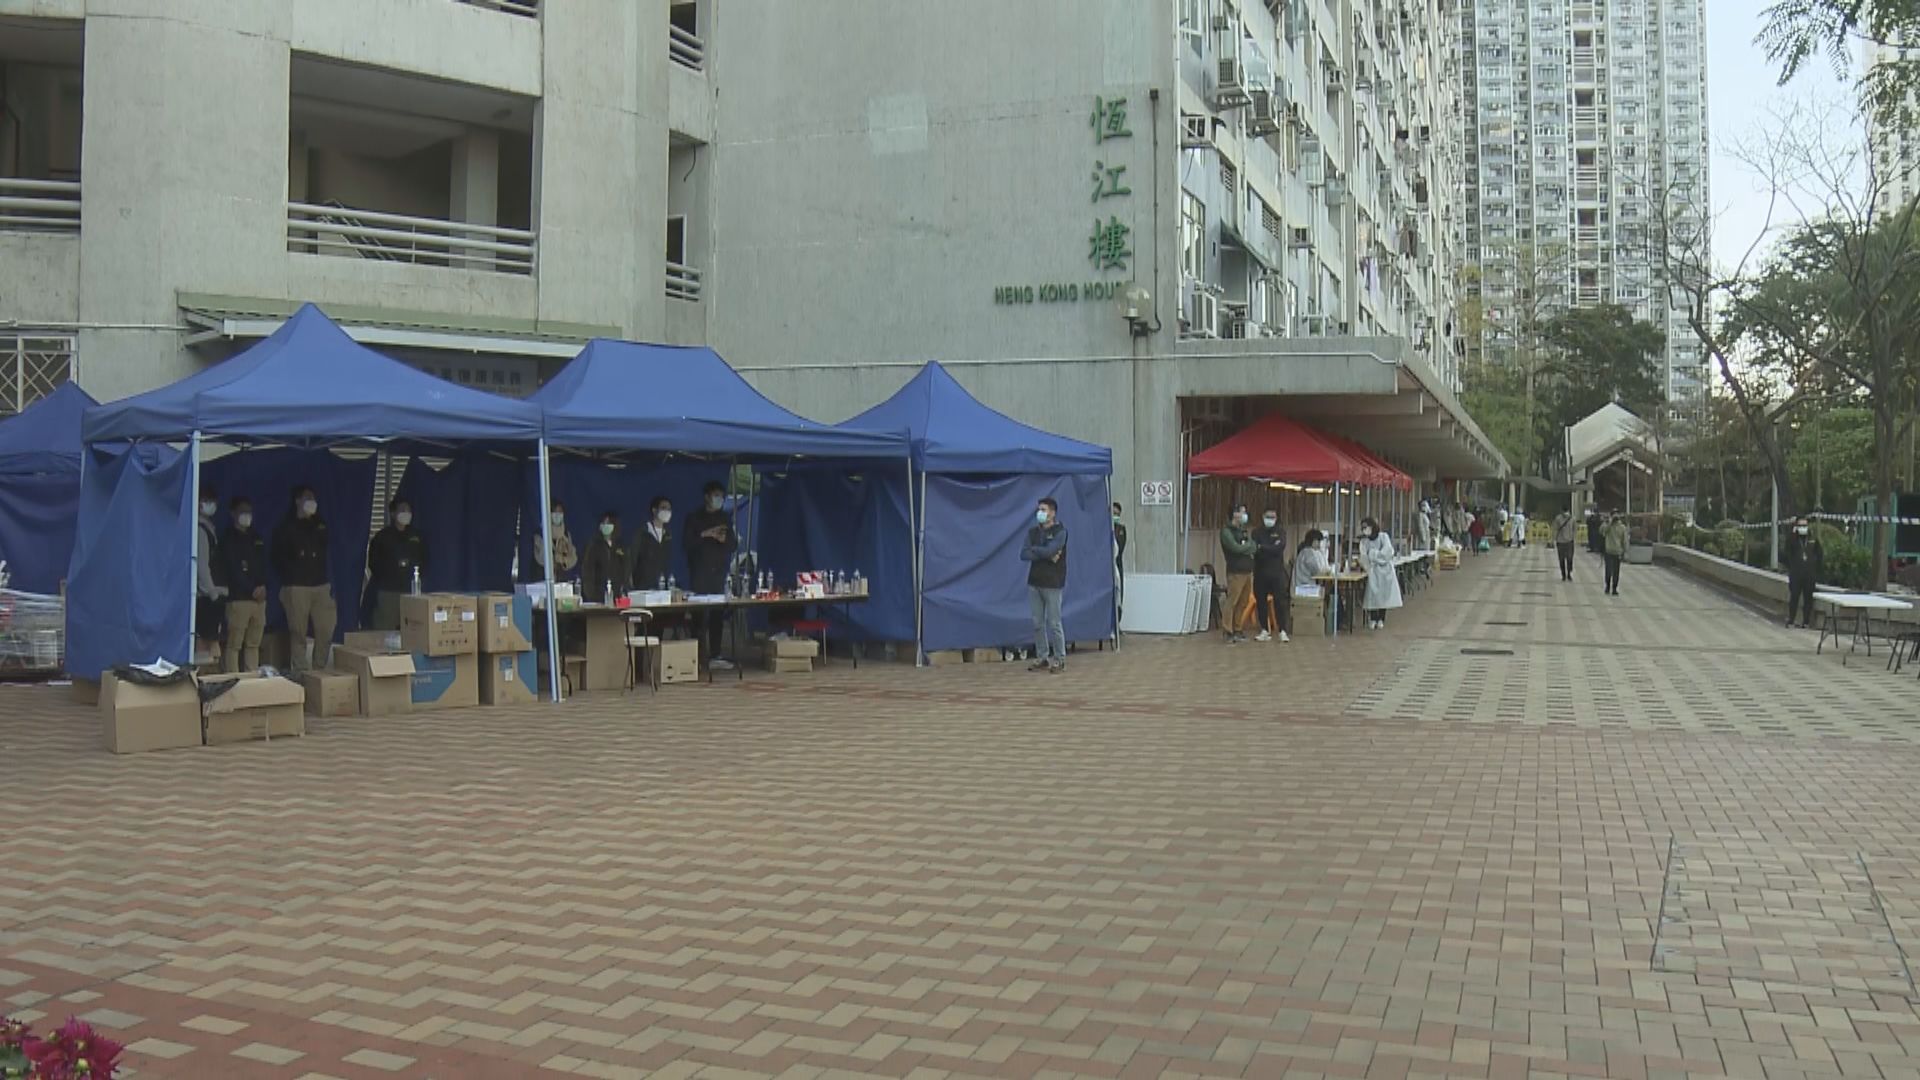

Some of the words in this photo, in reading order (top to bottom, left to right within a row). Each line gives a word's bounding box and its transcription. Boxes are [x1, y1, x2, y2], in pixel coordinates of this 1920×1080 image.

[995, 286, 1034, 305] HENG
[1039, 283, 1078, 303] KONG
[1084, 280, 1121, 300] HOU
